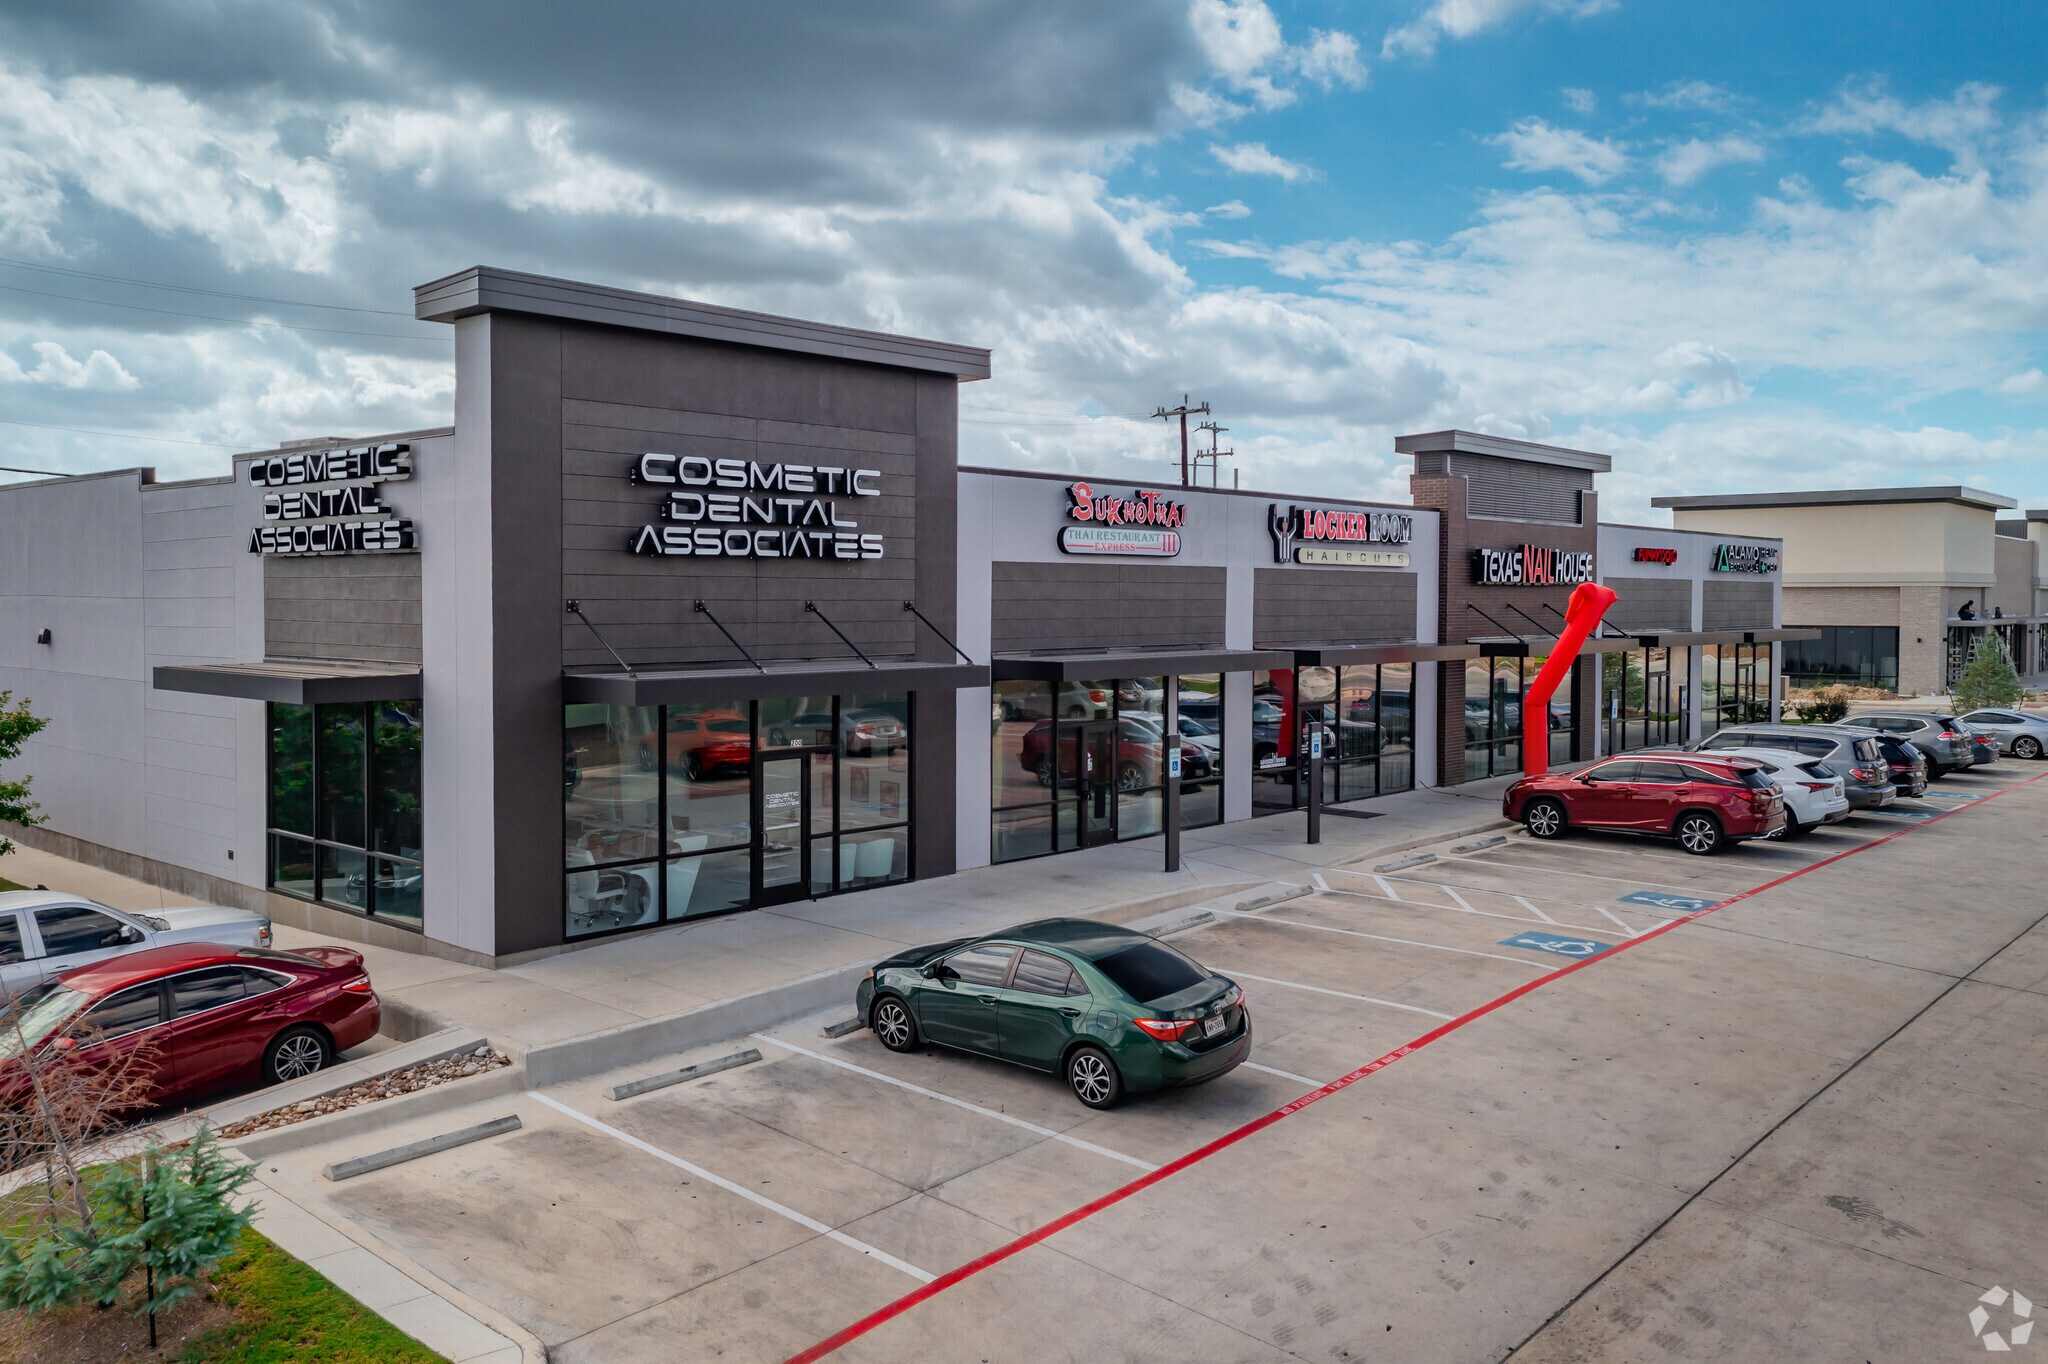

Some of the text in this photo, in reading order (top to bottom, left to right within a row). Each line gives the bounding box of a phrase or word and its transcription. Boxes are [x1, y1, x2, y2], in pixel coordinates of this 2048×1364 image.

[249, 444, 397, 487] COSMETIC
[641, 453, 881, 496] COSMETIC
[264, 487, 379, 520] DENTAL
[671, 492, 858, 528] DENTAL
[249, 520, 401, 553] ASSOCIATES
[635, 525, 884, 559] ASSOCIATES
[1067, 529, 1177, 553] THAI RESTAURANT III
[1303, 509, 1413, 543] LOCKER ROOM
[1094, 542, 1136, 552] EXPRESS
[1306, 550, 1404, 564] HAIRCUTS
[1729, 545, 1760, 560] ALAMO
[1481, 544, 1593, 584] TEXAS NAIL HOUSE
[764, 800, 800, 809] ASSOCIATES
[765, 791, 799, 800] COSMETIC
